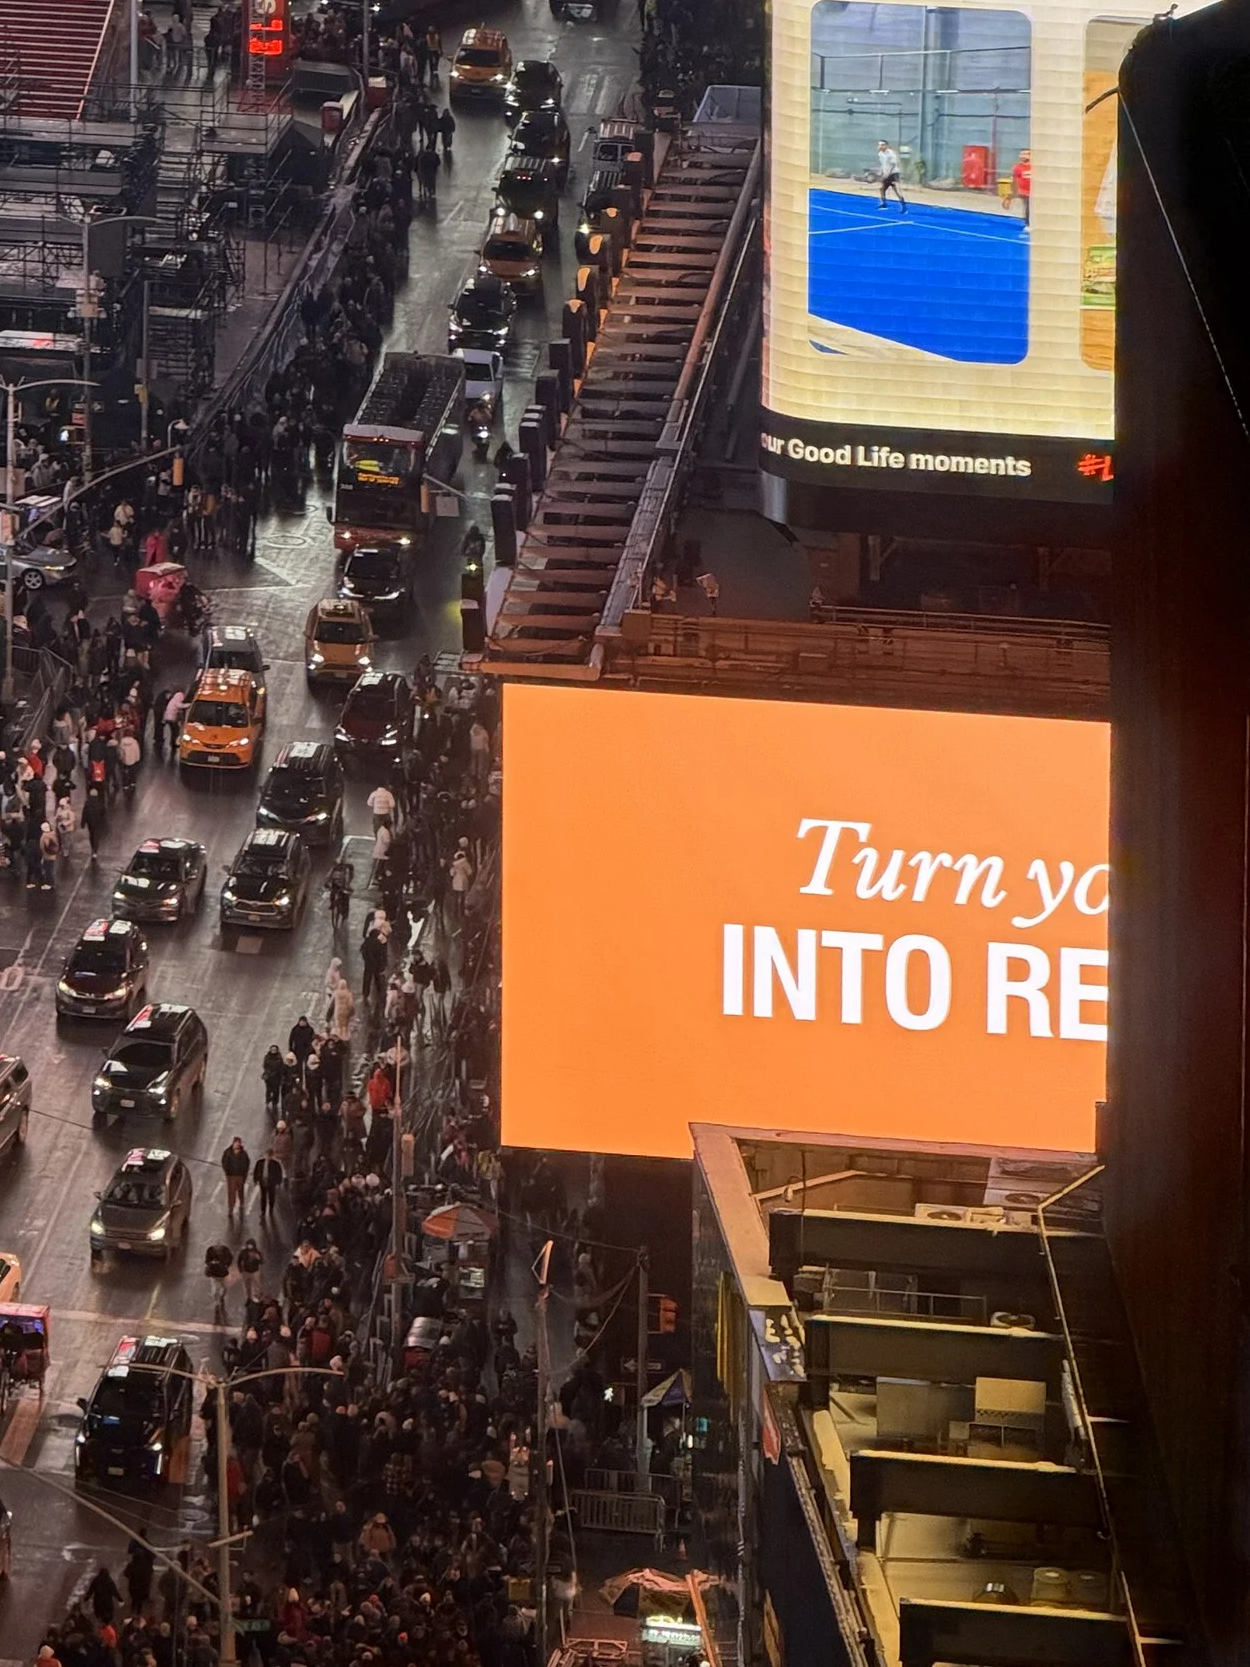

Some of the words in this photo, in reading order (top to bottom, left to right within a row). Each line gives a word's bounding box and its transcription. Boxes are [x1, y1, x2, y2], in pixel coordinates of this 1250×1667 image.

[787, 438, 852, 465] Good
[857, 445, 905, 469] Life
[909, 451, 1032, 477] moments
[796, 817, 1008, 909] Turn
[723, 923, 952, 1031] INTO
[986, 941, 1109, 1042] RE
